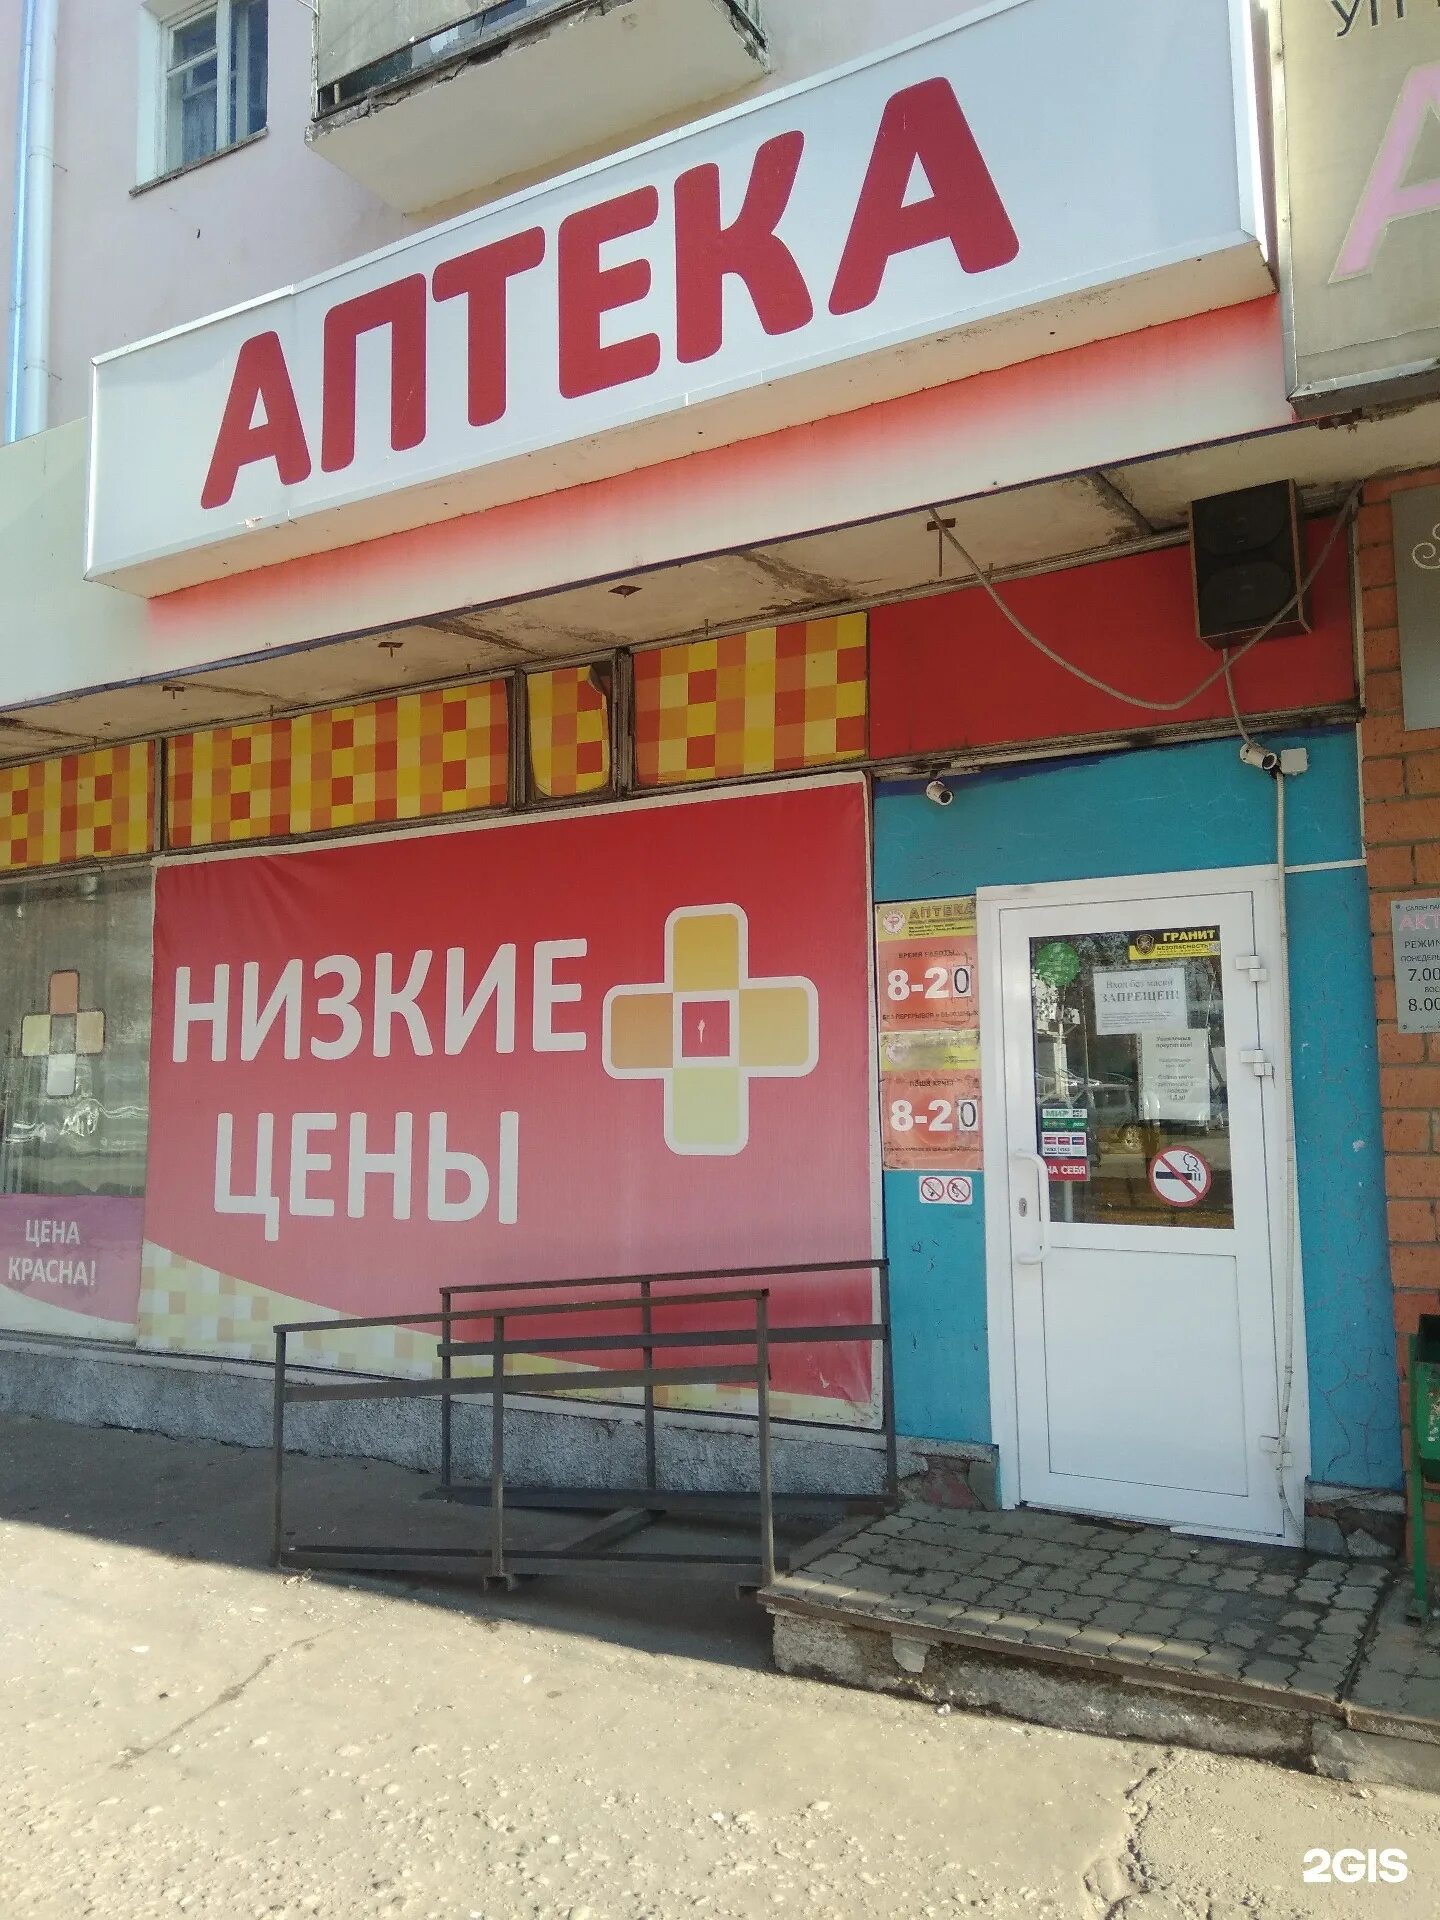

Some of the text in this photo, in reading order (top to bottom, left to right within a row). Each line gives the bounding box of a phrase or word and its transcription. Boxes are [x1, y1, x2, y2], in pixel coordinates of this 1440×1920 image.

[201, 77, 1020, 510] АПТЕКА
[909, 903, 977, 919] АПТЕКА
[1163, 930, 1216, 942] ГРАНИТ
[887, 966, 970, 1001] 8-20
[172, 938, 588, 1063] НИЗКИЕ
[890, 1099, 977, 1132] 8-20
[214, 1111, 519, 1241] ЦЕНЫ
[1061, 1165, 1086, 1175] СЕБЯ
[25, 1219, 80, 1248] ЦЕНА
[8, 1256, 96, 1286] КРАСНА!
